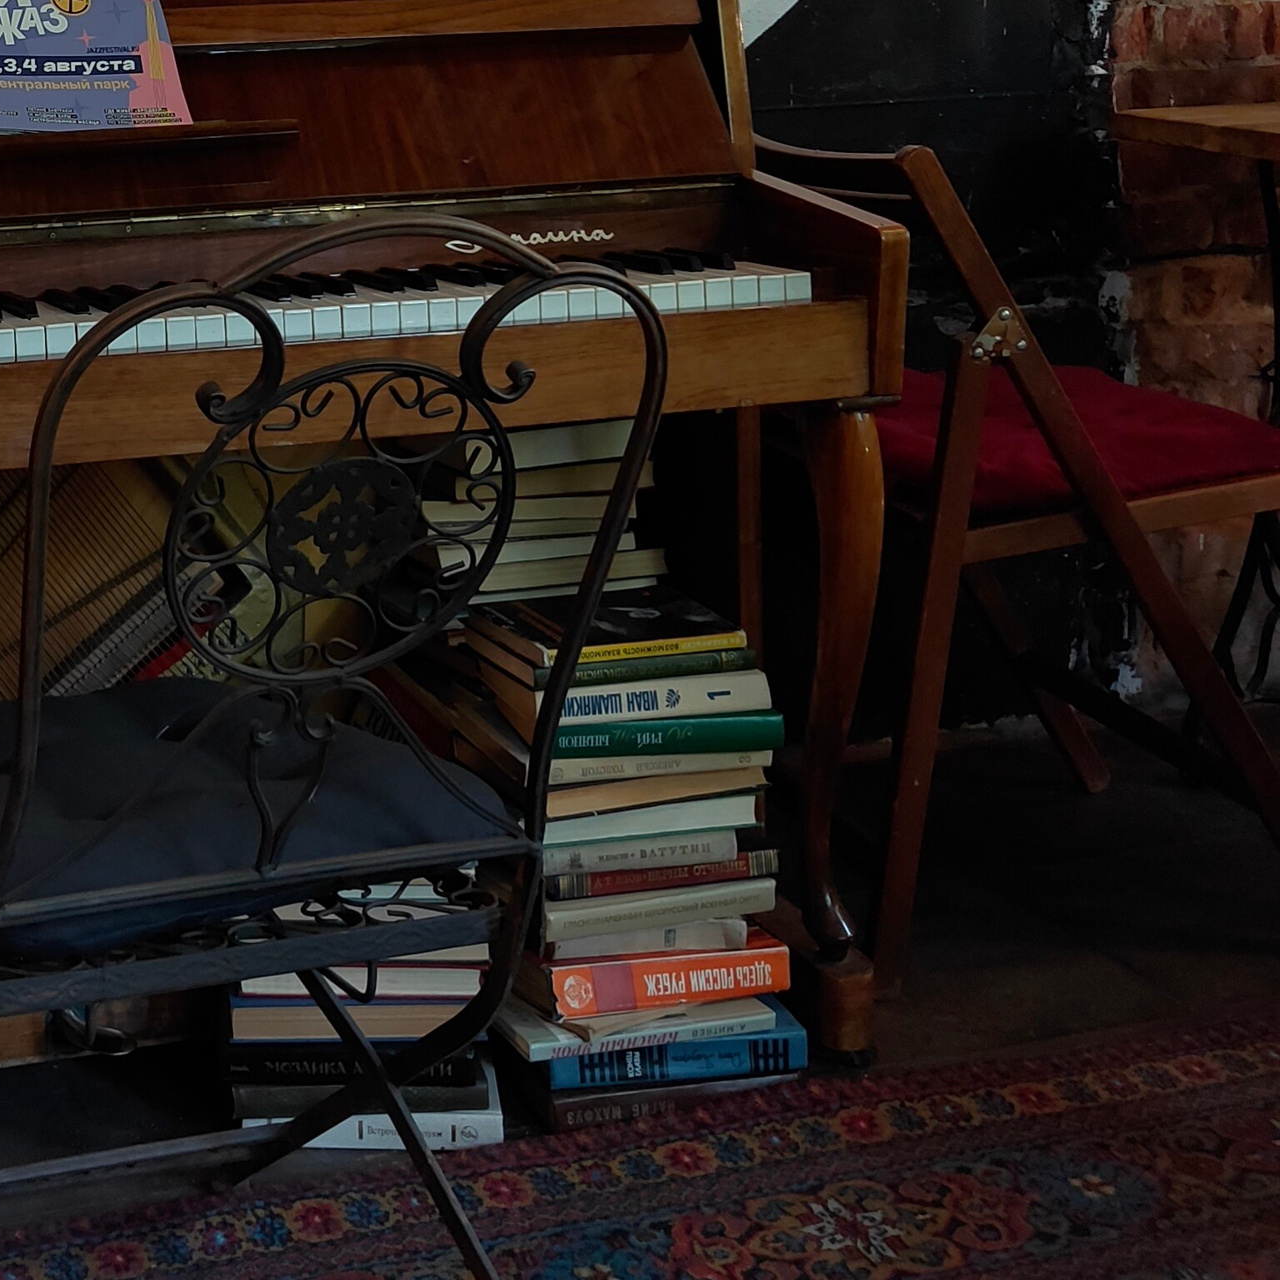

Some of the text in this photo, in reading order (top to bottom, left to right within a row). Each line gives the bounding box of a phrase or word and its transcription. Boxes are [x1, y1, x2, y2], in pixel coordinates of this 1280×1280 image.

[43, 58, 136, 76] августа
[94, 80, 130, 93] парк
[623, 643, 679, 656] ВОЗМОЖНОСТЬ
[626, 690, 659, 711] ИВАН
[581, 764, 625, 777] ТОЛСТОЙ
[640, 843, 711, 860] ВАТУТИН
[644, 960, 773, 997] ЗДЕСЬ РОССИИ РУБЕЖ
[691, 1024, 735, 1038] МИТЯЕВ
[264, 1060, 347, 1076] МОЗАИКА
[567, 1106, 621, 1125] МАХФУЗ
